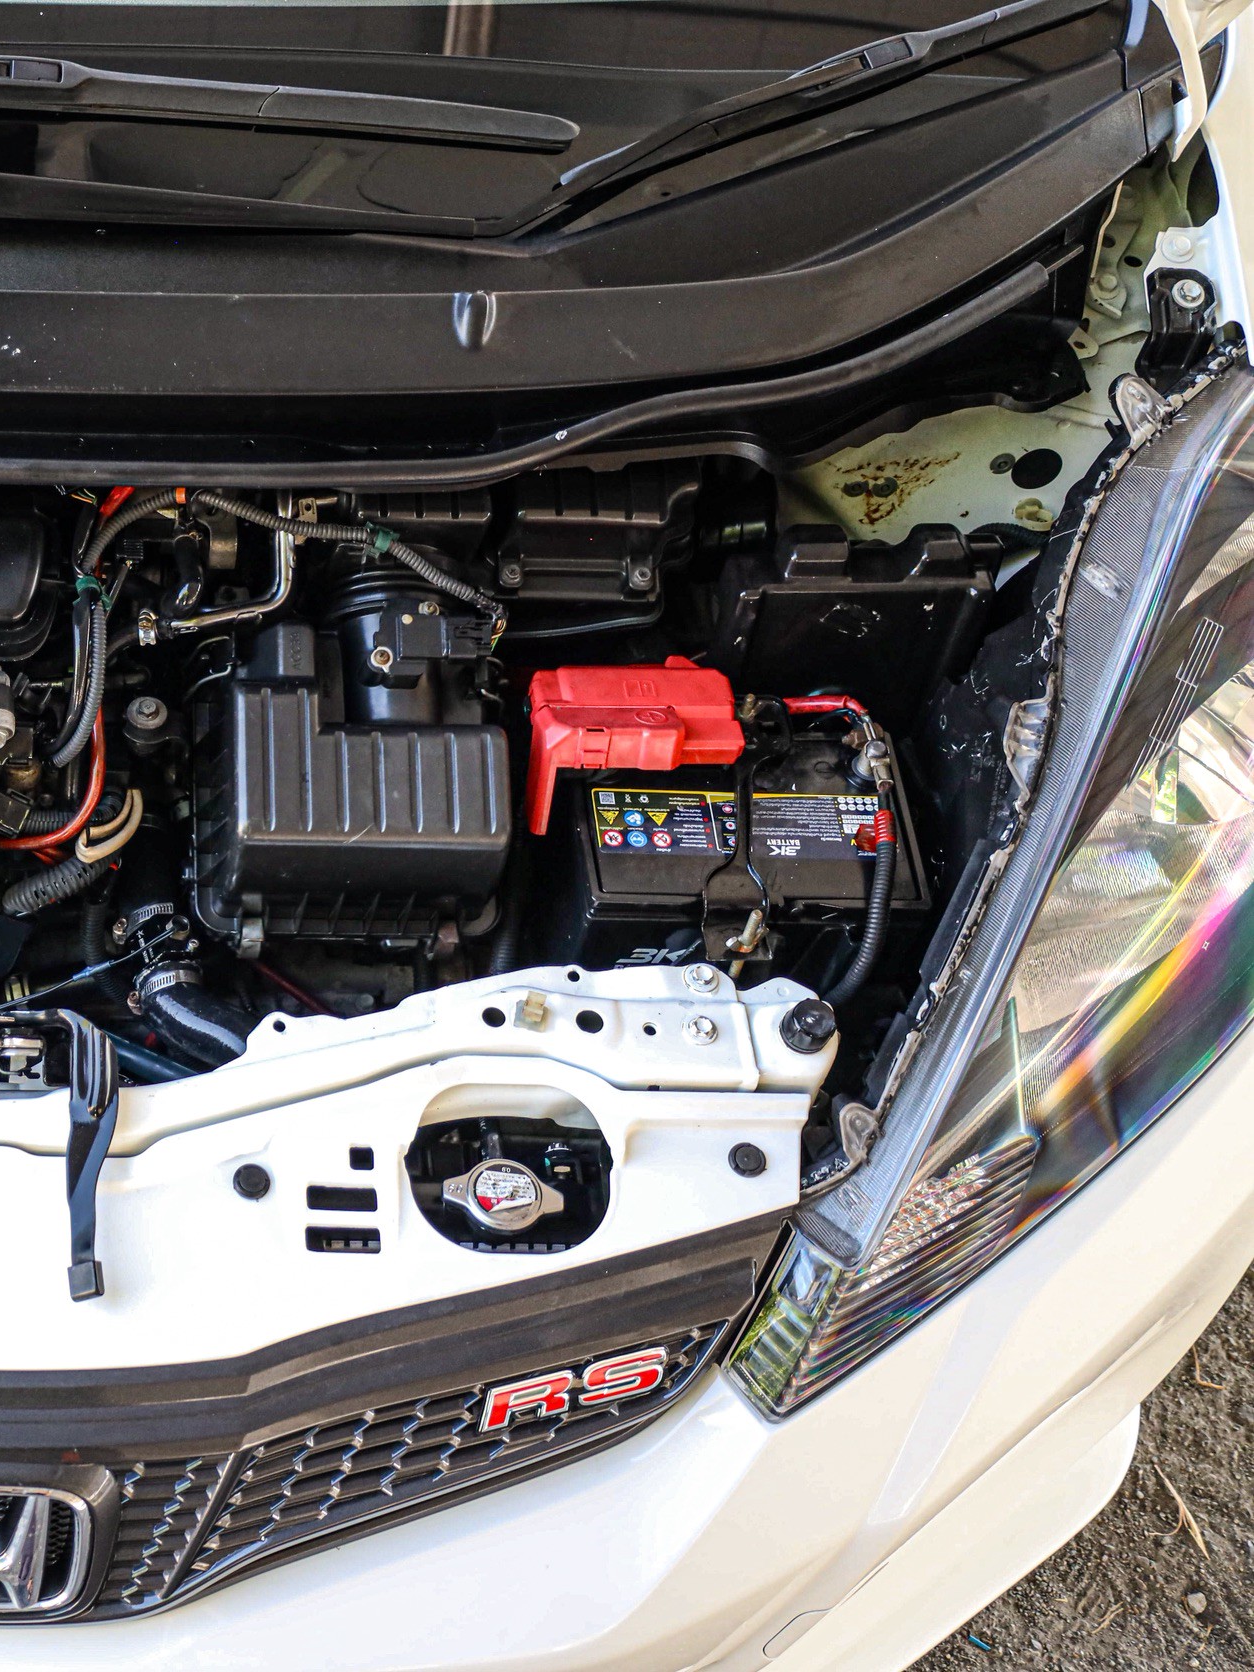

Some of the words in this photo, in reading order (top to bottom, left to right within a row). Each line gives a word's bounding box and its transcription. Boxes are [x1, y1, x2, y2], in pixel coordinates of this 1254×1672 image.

[766, 838, 801, 846] BATTERY
[768, 845, 801, 856] 3K
[615, 948, 688, 964] 3K
[478, 1346, 668, 1433] RS
